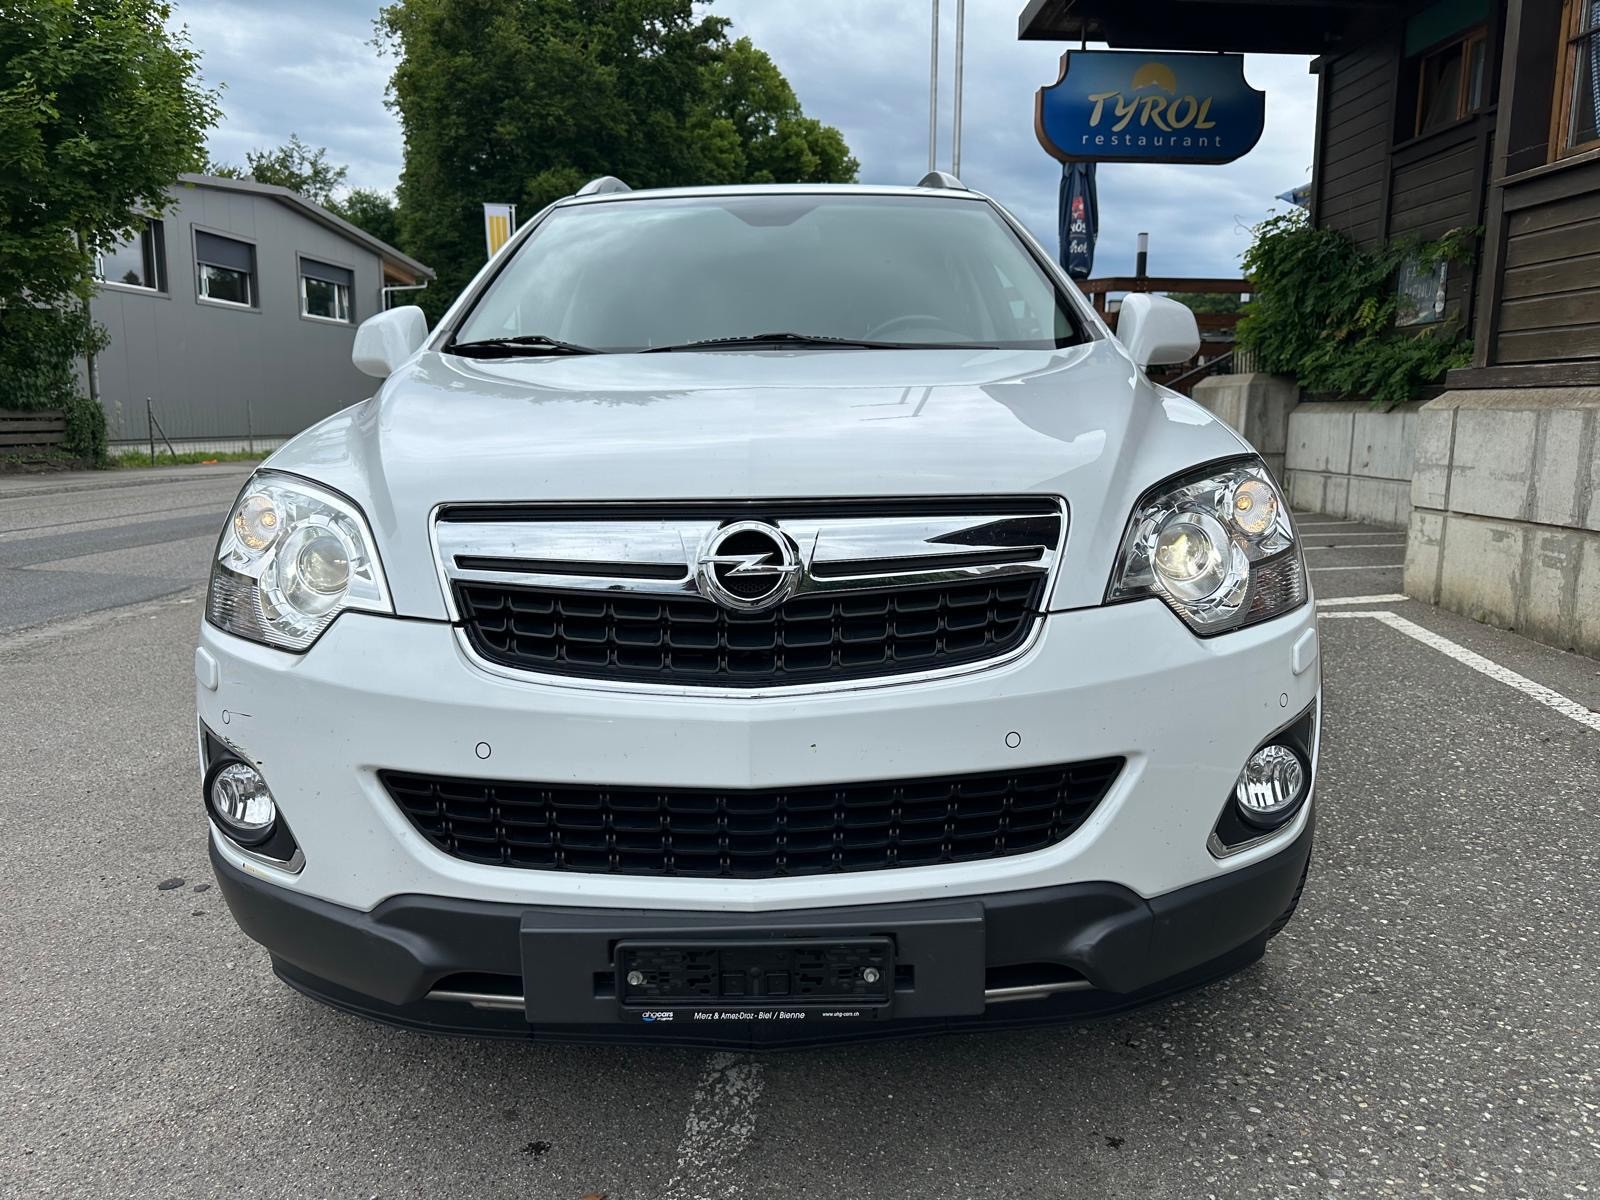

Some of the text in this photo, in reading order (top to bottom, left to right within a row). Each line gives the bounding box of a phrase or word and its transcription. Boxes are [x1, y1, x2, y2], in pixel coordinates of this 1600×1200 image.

[1088, 90, 1216, 132] TYROL
[1082, 134, 1221, 147] restaurant
[694, 1011, 712, 1020] Merz
[713, 1011, 720, 1020] &
[758, 1011, 772, 1020] Biel
[779, 1011, 806, 1020] Bienne
